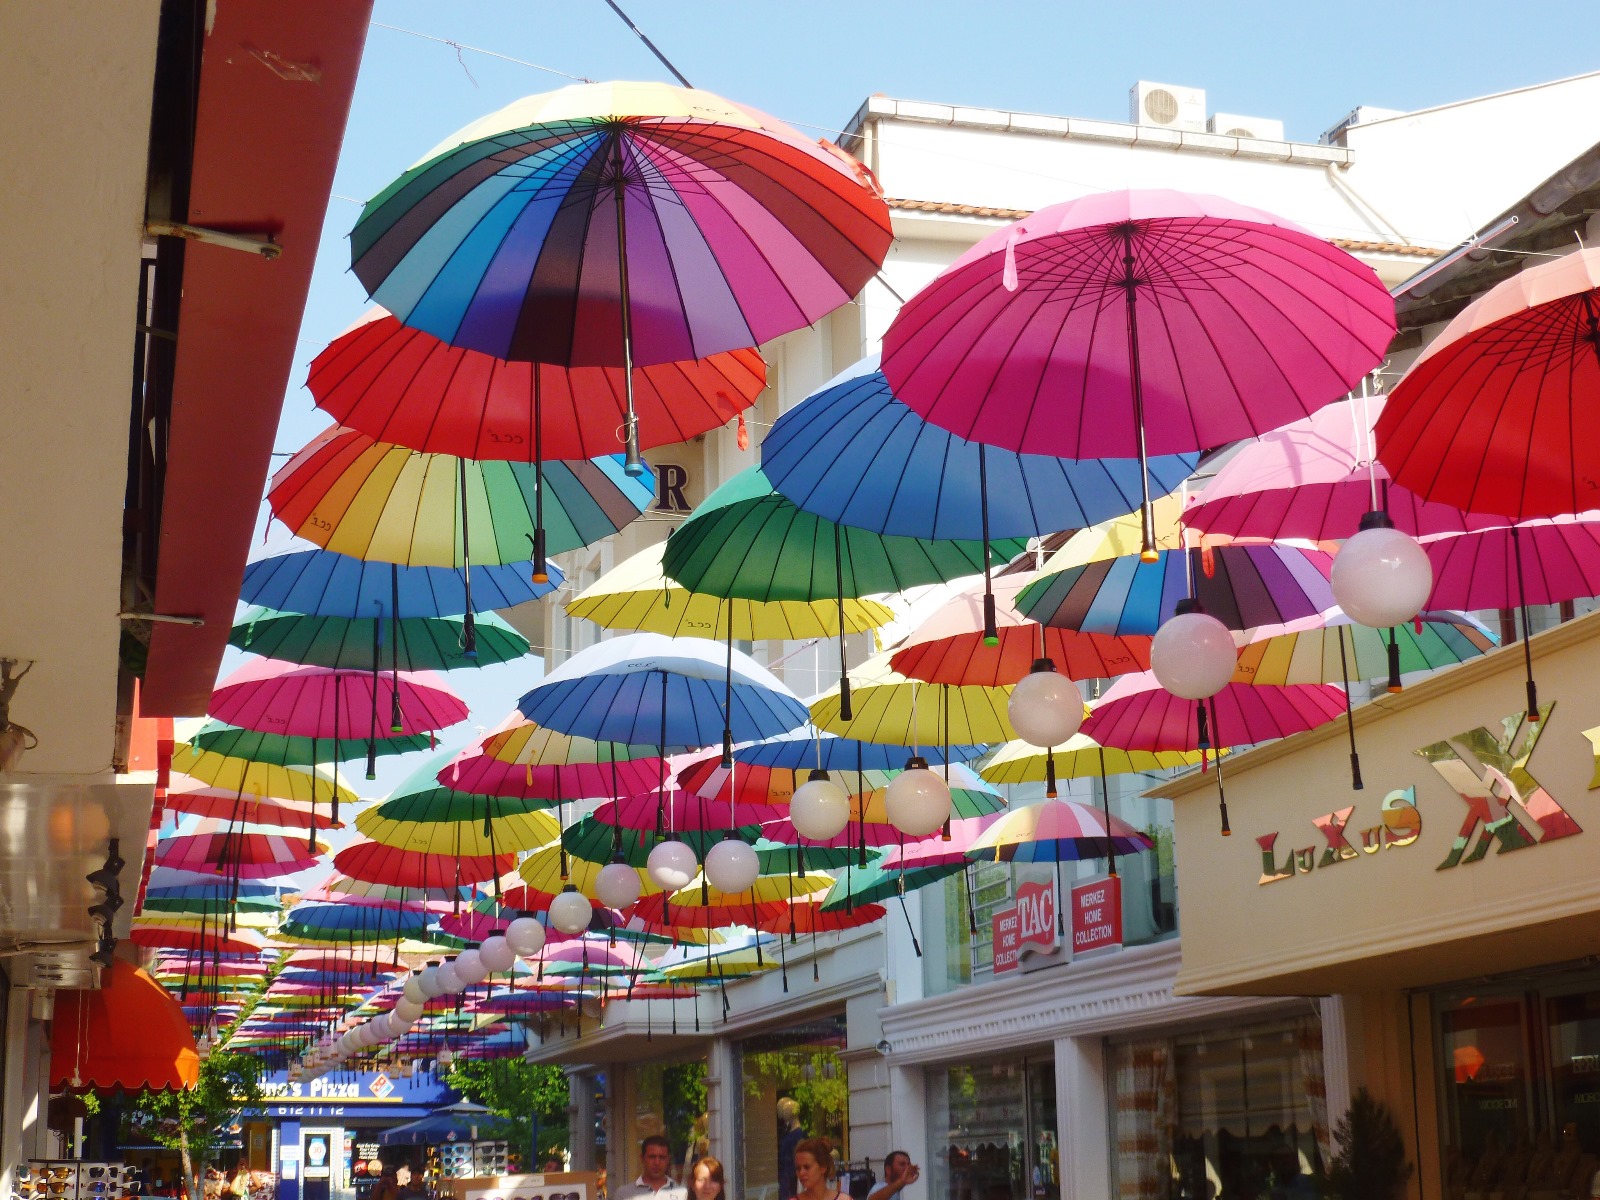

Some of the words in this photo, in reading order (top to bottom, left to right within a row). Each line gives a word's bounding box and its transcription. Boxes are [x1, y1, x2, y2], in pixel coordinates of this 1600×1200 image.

[654, 464, 692, 511] R
[1081, 889, 1104, 908] MERKEZ
[1018, 889, 1052, 938] TAC
[1084, 908, 1101, 925] HOME
[1000, 916, 1017, 932] MERKEZ
[1002, 933, 1016, 948] HOME
[1075, 924, 1112, 945] COLLECTION
[310, 1077, 359, 1098] Pizza
